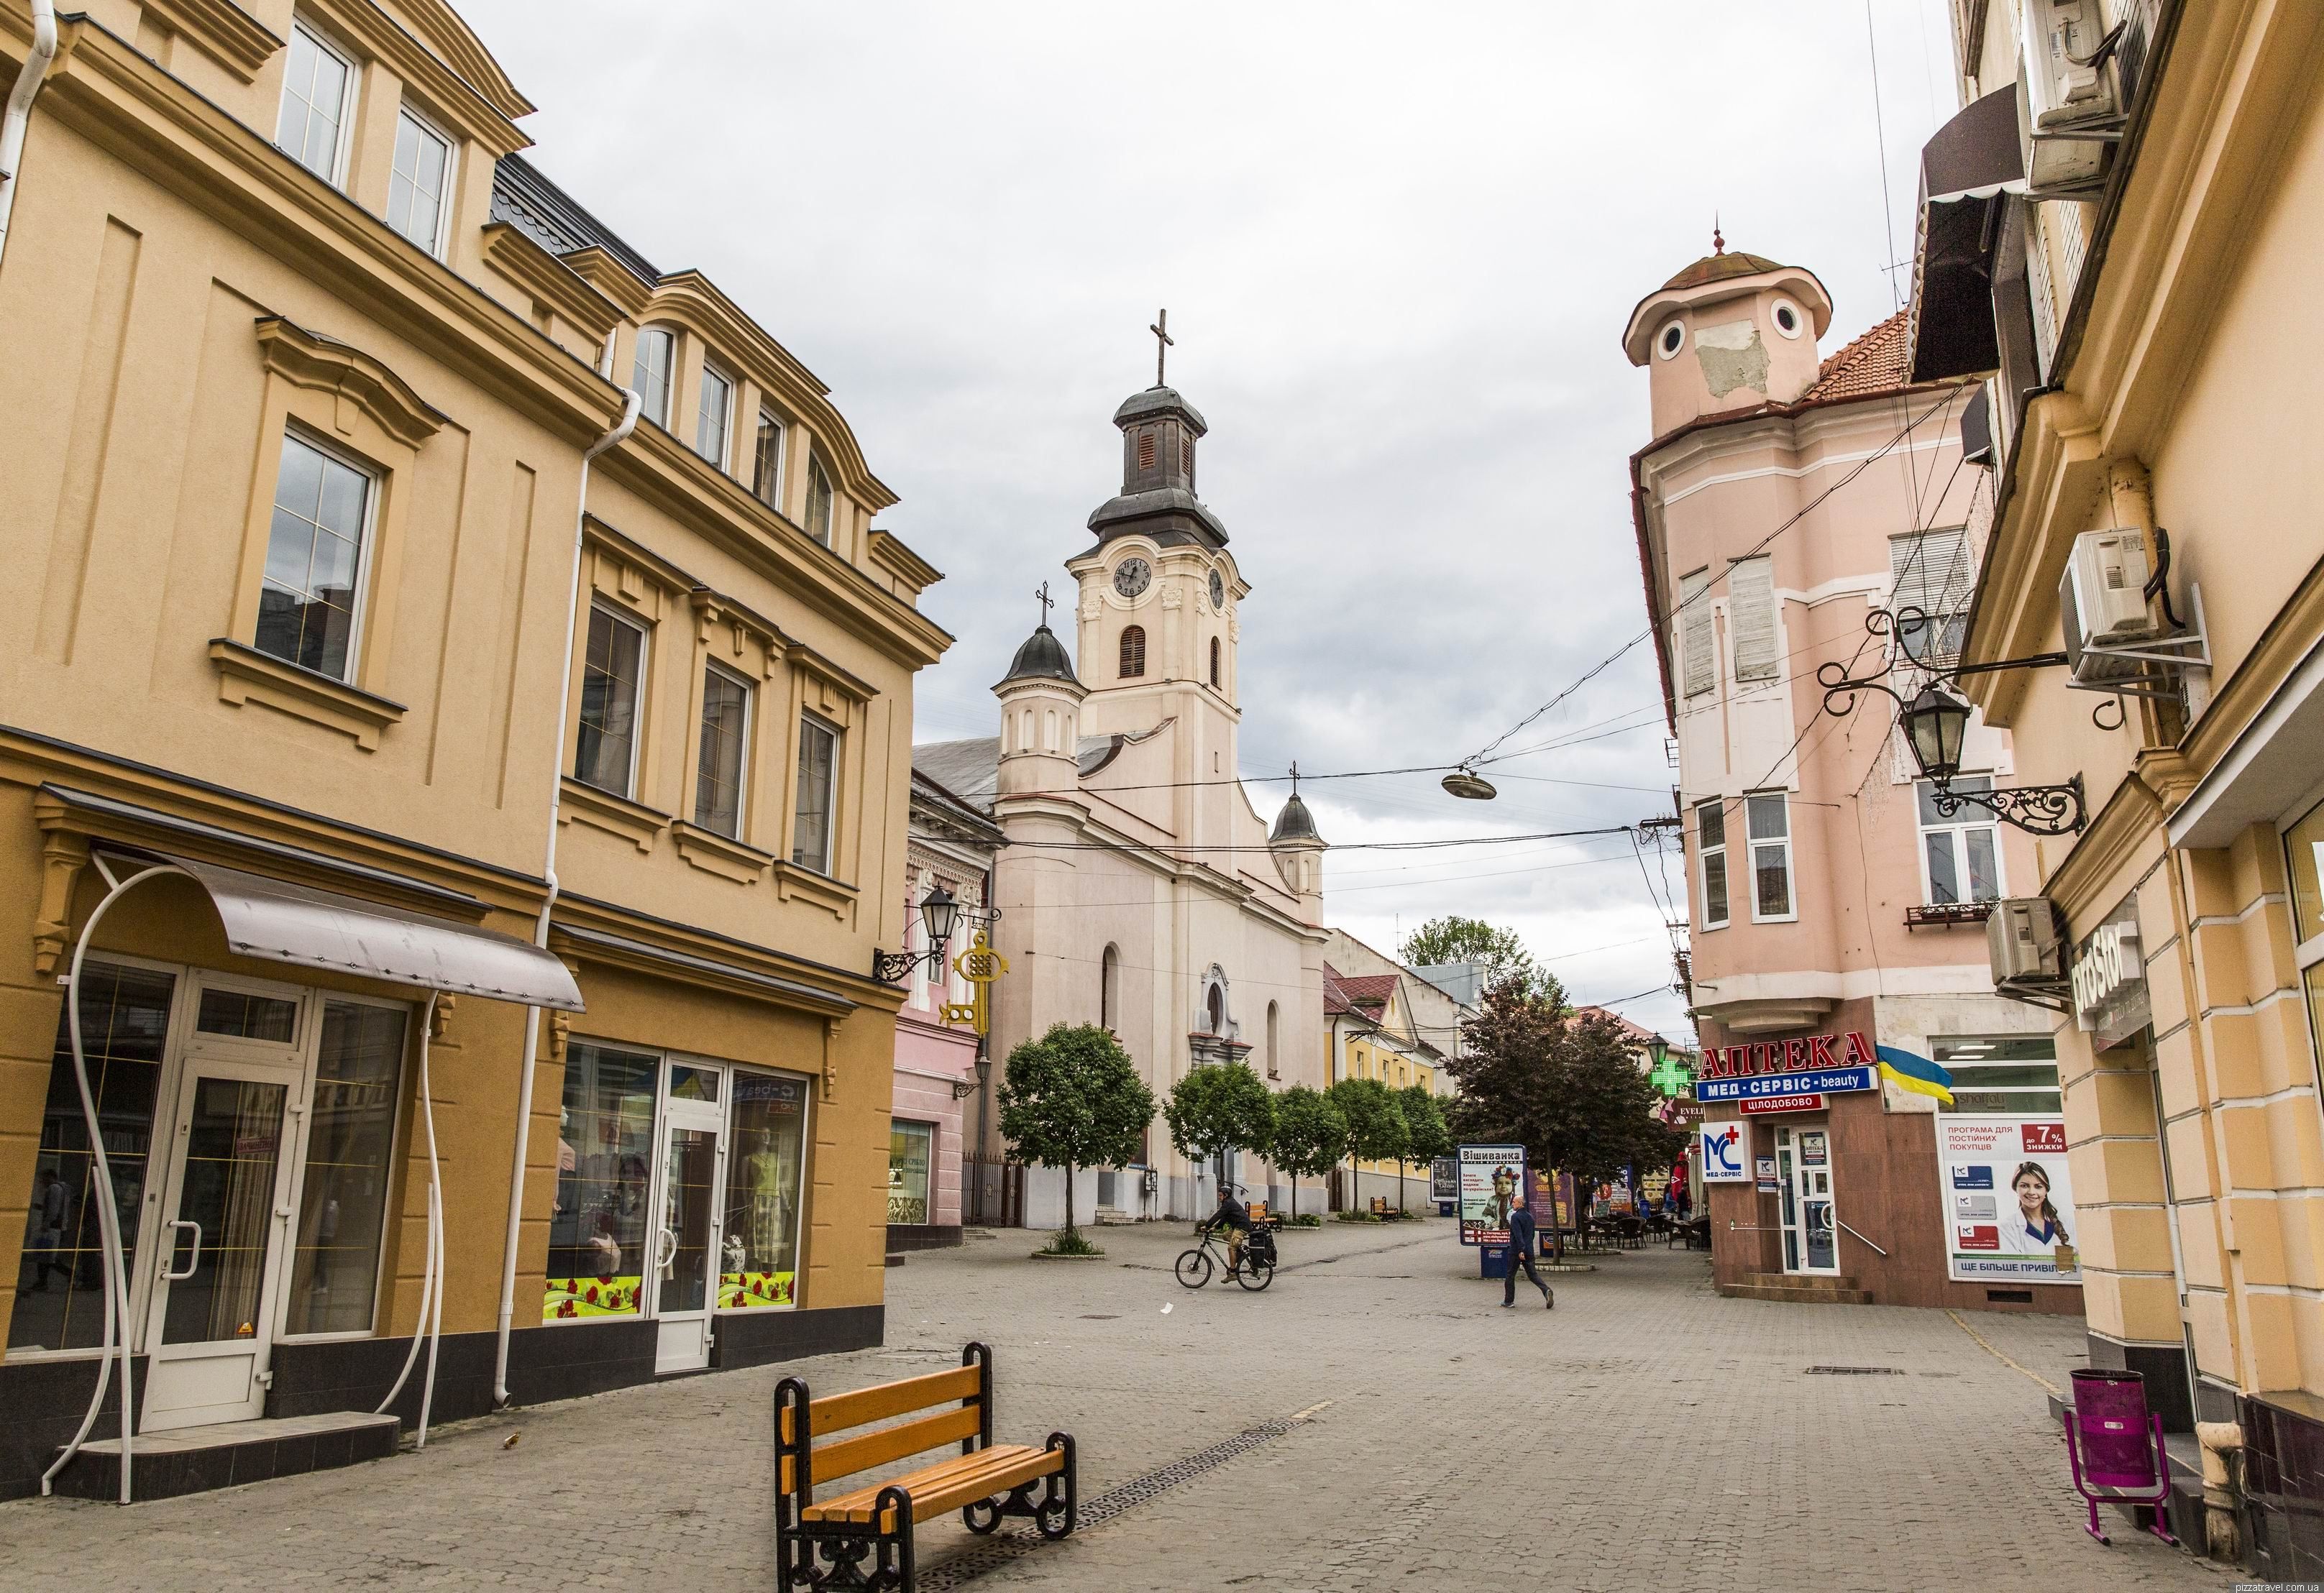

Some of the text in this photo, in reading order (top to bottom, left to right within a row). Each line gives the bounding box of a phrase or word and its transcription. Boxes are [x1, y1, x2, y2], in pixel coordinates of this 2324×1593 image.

[1698, 1032, 1873, 1079] АПТЕКА
[1747, 1097, 1813, 1110] ЦІЛОДОБОВО
[1463, 1150, 1520, 1160] Вішиванка
[1961, 1262, 1977, 1272] ЩЕ
[1980, 1263, 2019, 1272] БІЛЬШЕ
